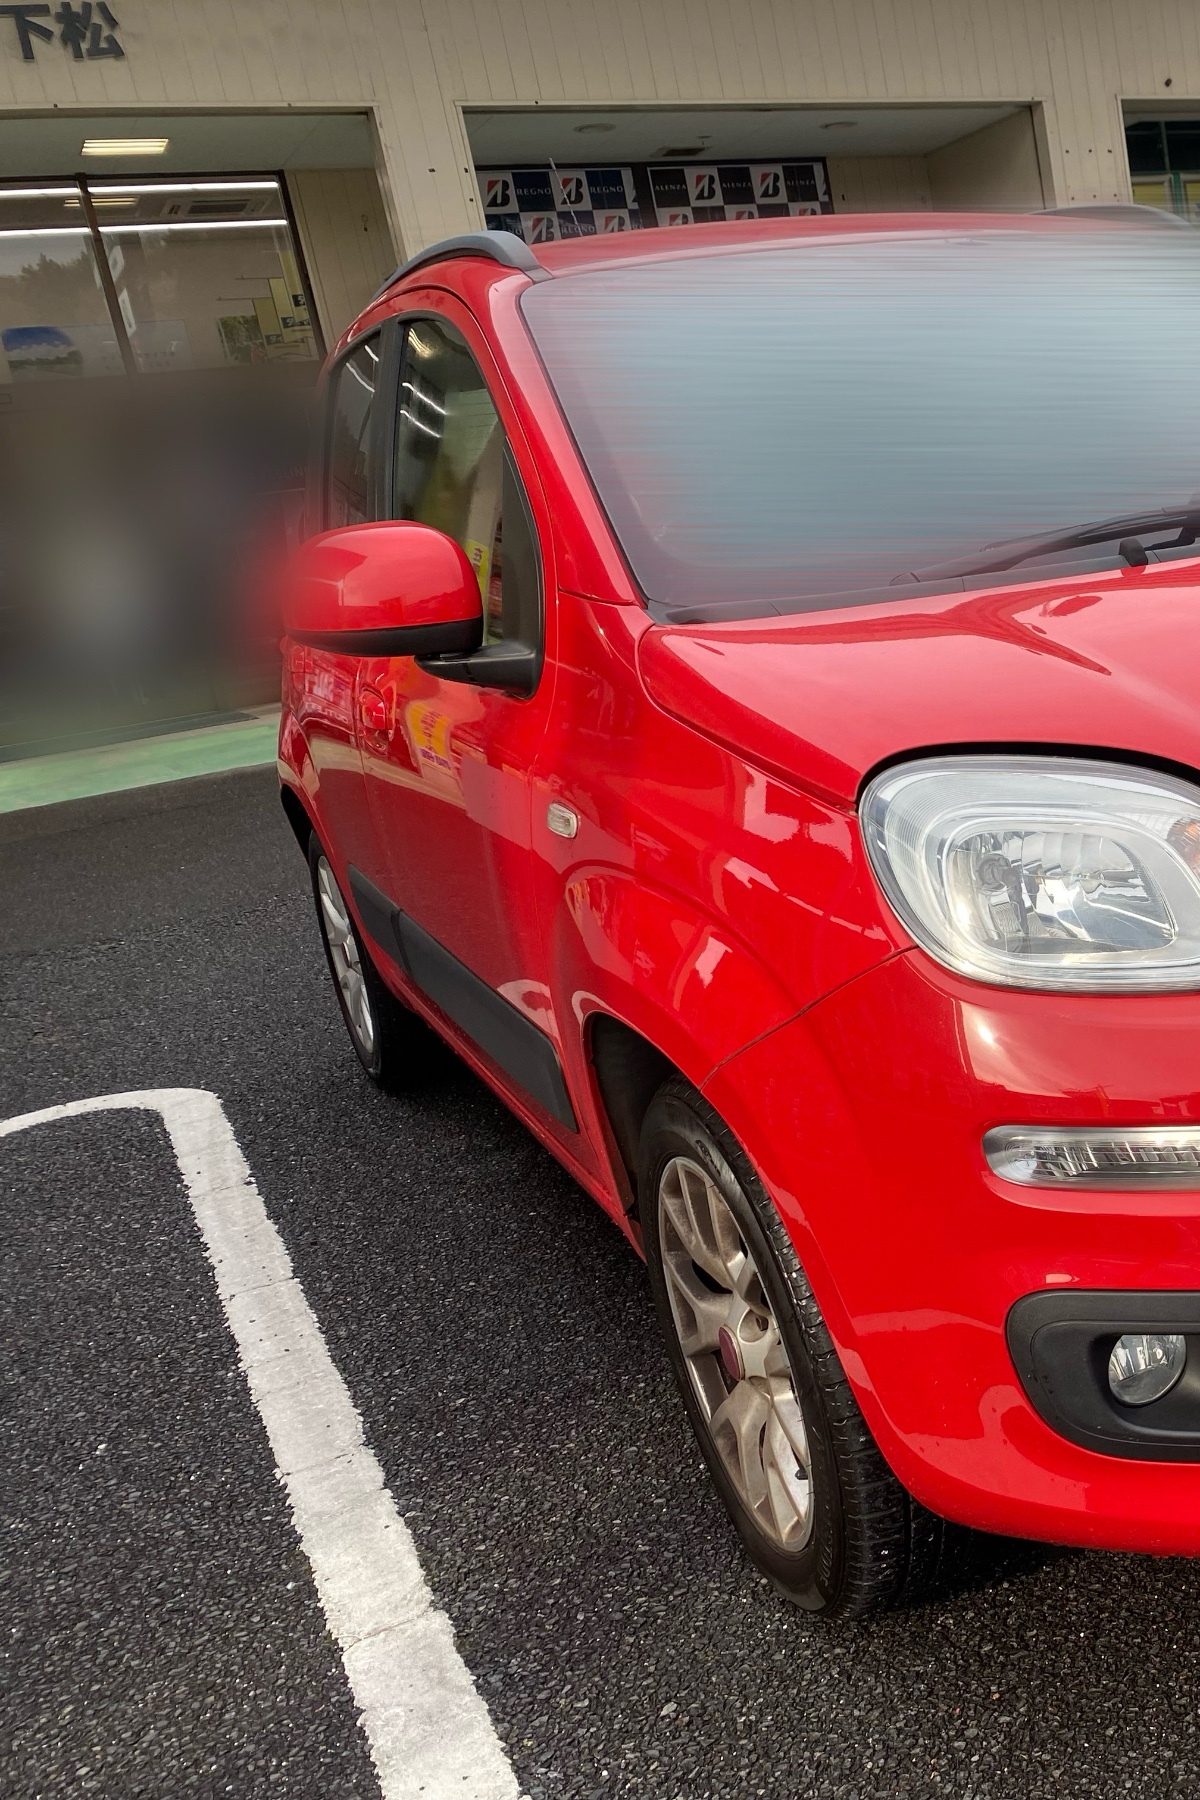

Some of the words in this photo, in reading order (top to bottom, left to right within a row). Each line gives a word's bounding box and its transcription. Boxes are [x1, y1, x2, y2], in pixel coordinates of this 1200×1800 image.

[0, 2, 125, 60] 下松
[516, 186, 552, 196] REGNO
[590, 185, 624, 194] REGNO
